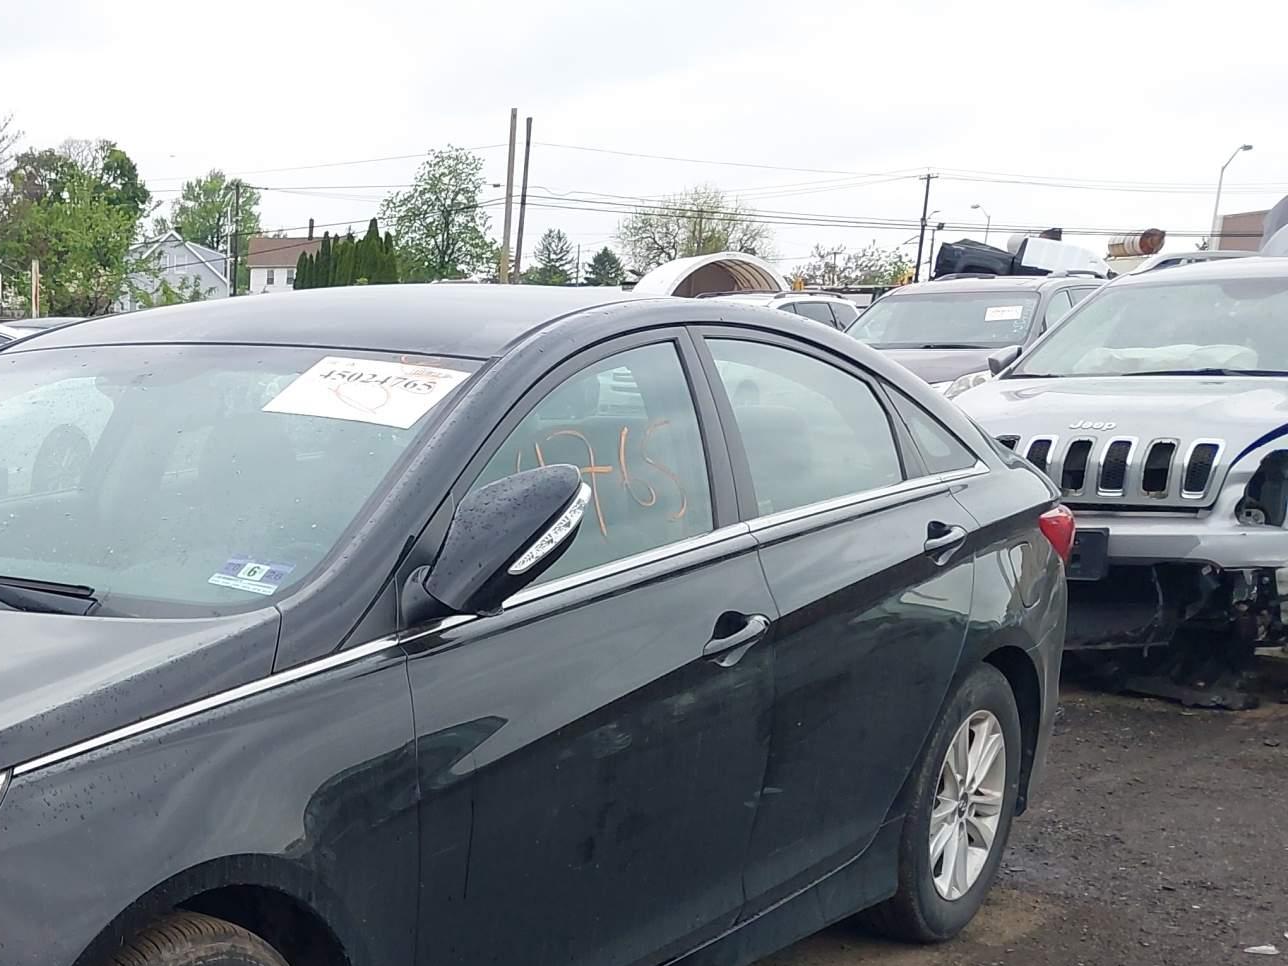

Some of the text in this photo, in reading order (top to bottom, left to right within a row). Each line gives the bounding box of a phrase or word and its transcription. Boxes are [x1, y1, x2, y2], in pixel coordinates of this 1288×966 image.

[319, 368, 438, 392] 45024765
[1069, 420, 1116, 431] Jeep
[248, 566, 260, 576] 6
